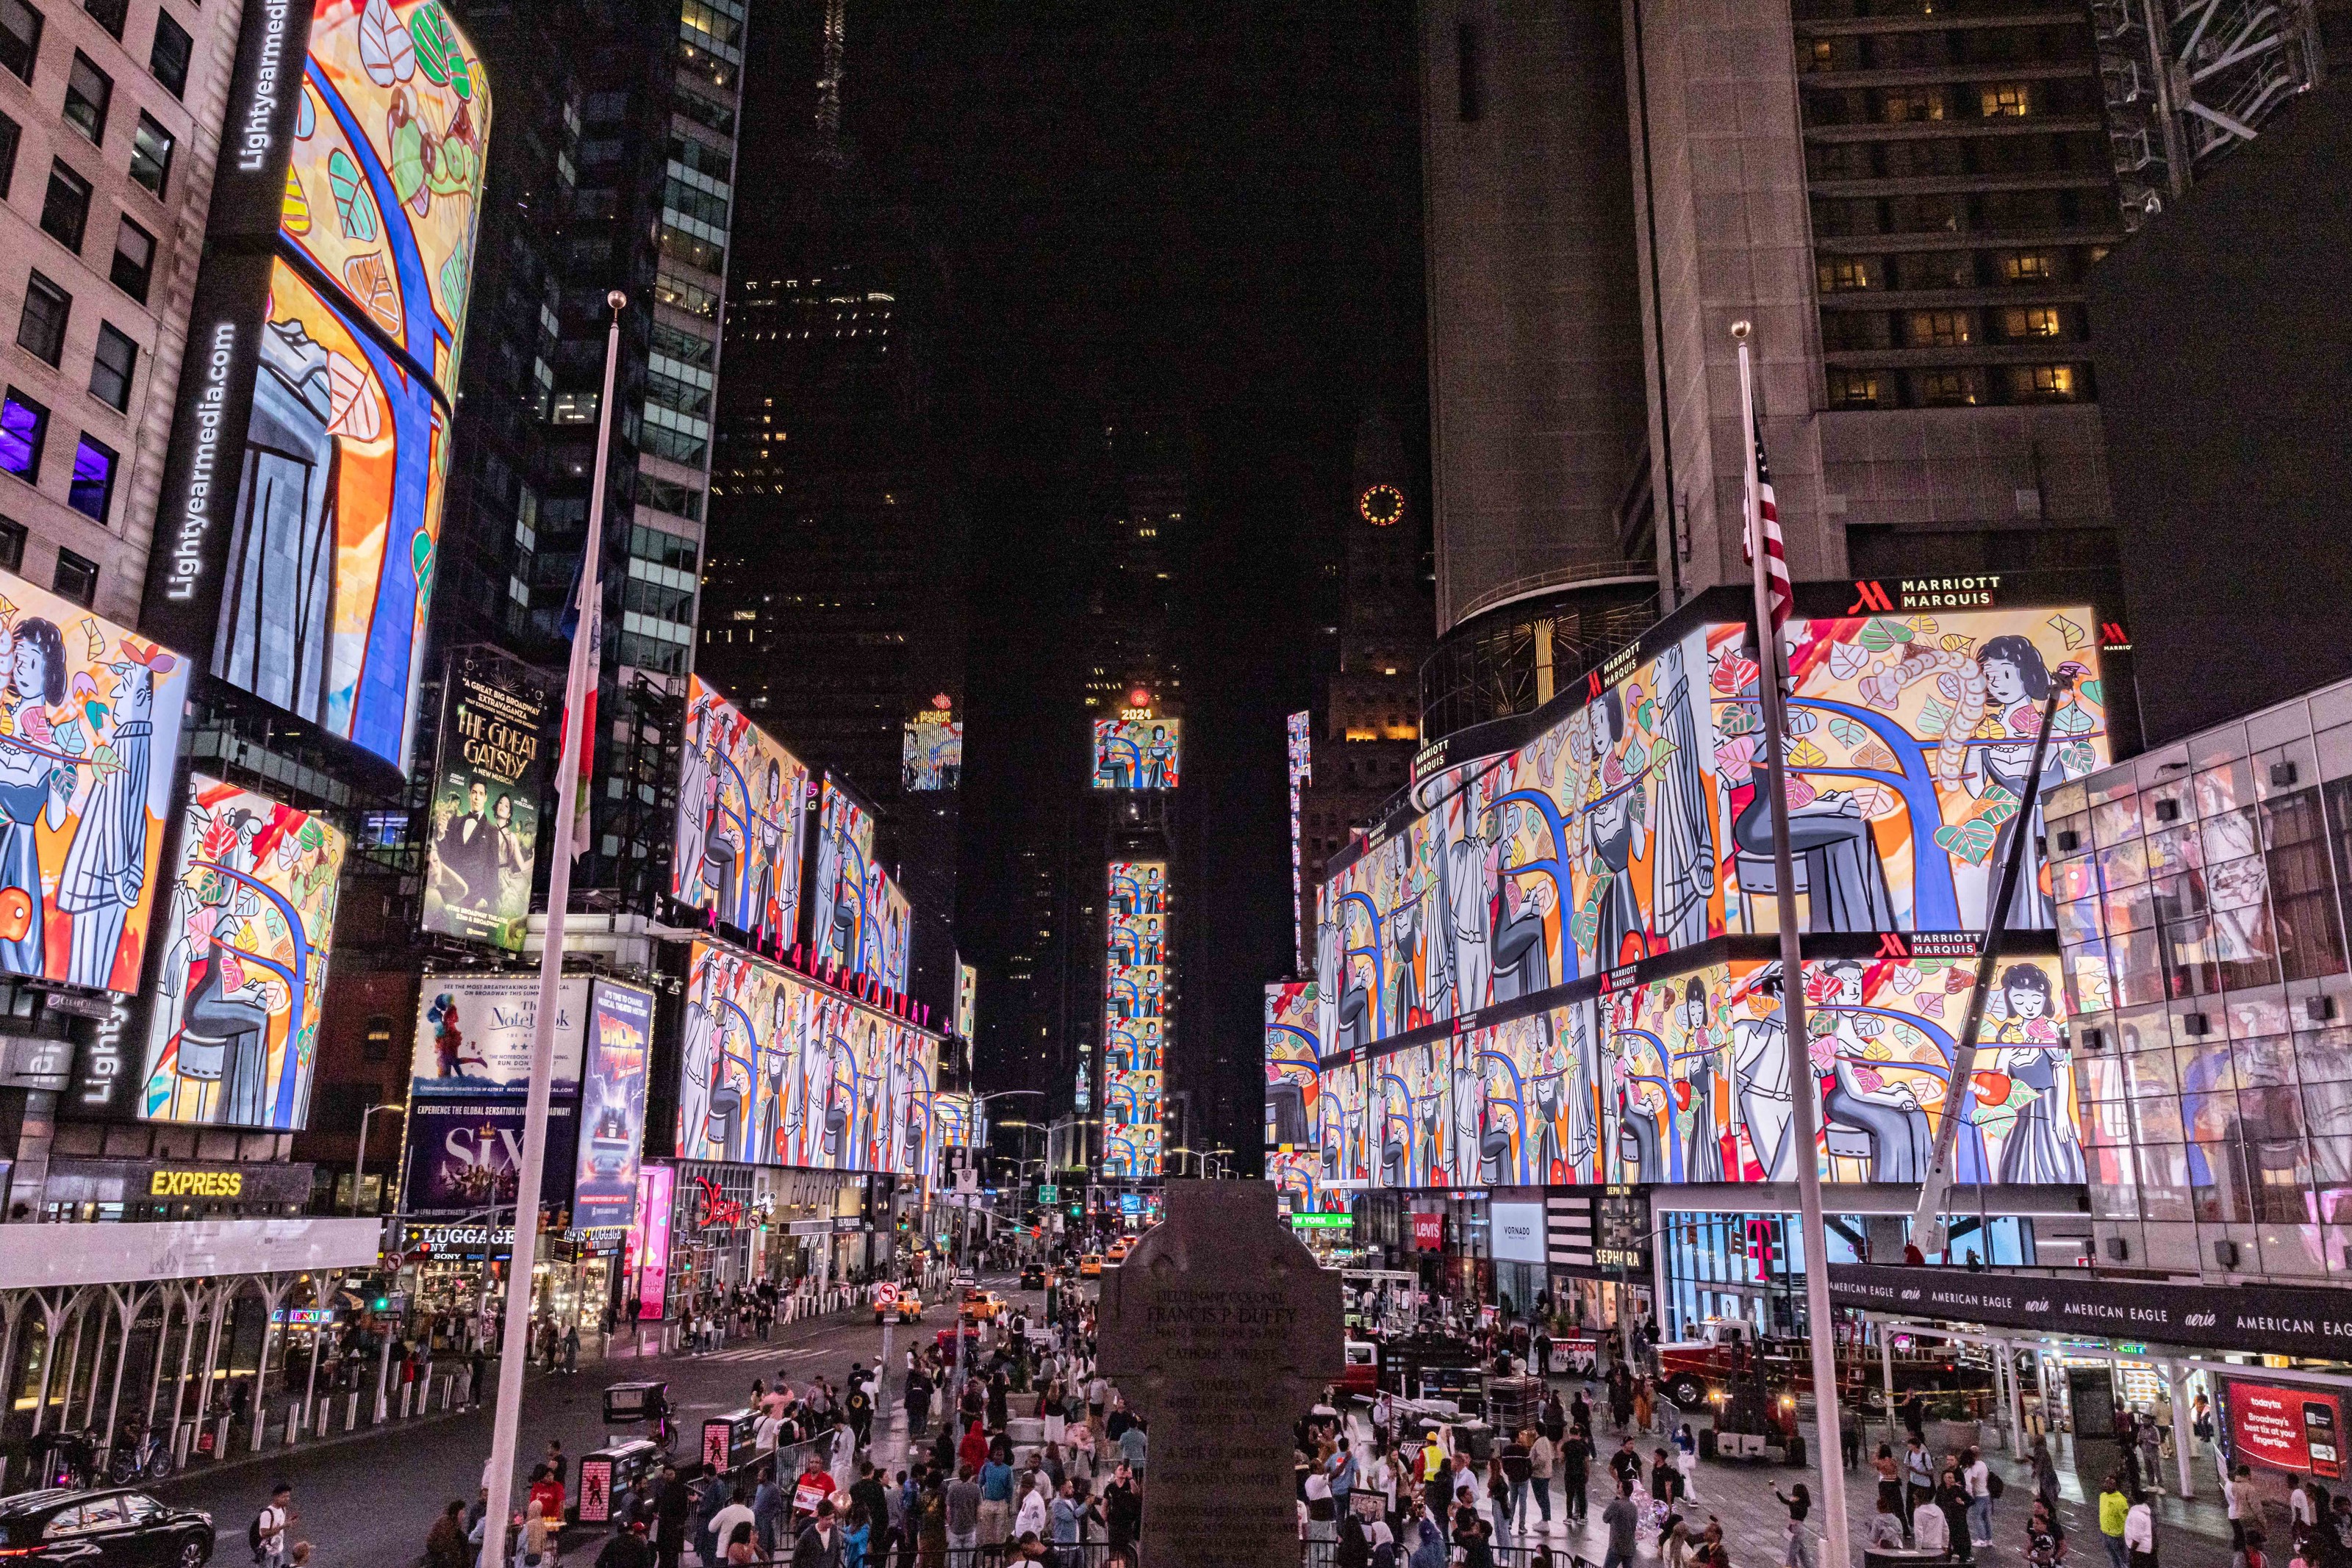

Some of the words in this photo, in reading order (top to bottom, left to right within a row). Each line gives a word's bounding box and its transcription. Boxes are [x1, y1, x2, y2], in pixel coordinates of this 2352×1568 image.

[167, 323, 234, 600] Lightyearmedia.com
[1901, 576, 2000, 591] MARRIOTT
[1903, 592, 1990, 608] MARQUIS
[1604, 641, 1640, 675] MARRIOTT
[1605, 659, 1636, 688] MARQUIS
[478, 694, 527, 720] EXTRAVAGANZA
[494, 691, 505, 701] BIG
[506, 695, 540, 716] BROADWAY
[1121, 708, 1152, 720] 2024
[459, 711, 487, 741] THE
[488, 722, 537, 761] GREAT
[464, 738, 528, 779] GATSBY
[1416, 740, 1449, 766] MARRIOTT
[478, 769, 492, 779] NEW
[1416, 755, 1444, 779] MARQUIS
[1369, 822, 1387, 839] MARRIOTT
[1912, 934, 1981, 943] MARRIOTT
[1914, 945, 1973, 954] MARQUIS
[1612, 965, 1637, 979] MARRIOTT
[1612, 976, 1635, 988] MARQUIS
[521, 1001, 537, 1010] Th
[417, 1105, 451, 1115] EXPERIENCE
[451, 1106, 462, 1115] THE
[463, 1106, 484, 1115] GLOBAL
[485, 1107, 515, 1115] SENSATION
[517, 1107, 527, 1115] LIV
[1943, 1118, 1954, 1141] SHORE
[1949, 1098, 1959, 1118] NEON
[1954, 1082, 1962, 1098] SIGN
[445, 1127, 525, 1173] SIX
[151, 1170, 242, 1196] EXPRESS
[1607, 1187, 1630, 1195] SEPHRA
[423, 1229, 514, 1244] LUGGAGE
[590, 1229, 622, 1240] LUGGAGE
[1504, 1226, 1530, 1236] VORNADO
[430, 1243, 447, 1252] NY
[1147, 1306, 1216, 1323] FRANCIS
[1222, 1308, 1231, 1323] P
[1238, 1308, 1297, 1323] DUFFY
[1829, 1281, 1867, 1294] AMERICAN
[1870, 1286, 1893, 1298] EAGLE
[1901, 1287, 1921, 1301] aerie
[1932, 1292, 1978, 1306] AMERICAN
[1984, 1296, 2012, 1309] EAGLE
[2025, 1297, 2049, 1312] aerie
[2064, 1302, 2123, 1320] AMERICAN
[2130, 1308, 2168, 1323] EAGLE
[2184, 1310, 2216, 1328] aerie
[2236, 1315, 2315, 1334] AMERICAN
[1552, 1343, 1596, 1352] HICAGO
[2251, 1398, 2281, 1409] todaytix
[2248, 1412, 2289, 1427] Broadway's
[2244, 1422, 2259, 1432] best
[2260, 1425, 2270, 1434] tix
[2271, 1427, 2279, 1436] at
[2280, 1430, 2296, 1439] your
[2253, 1434, 2290, 1449] fingertips.
